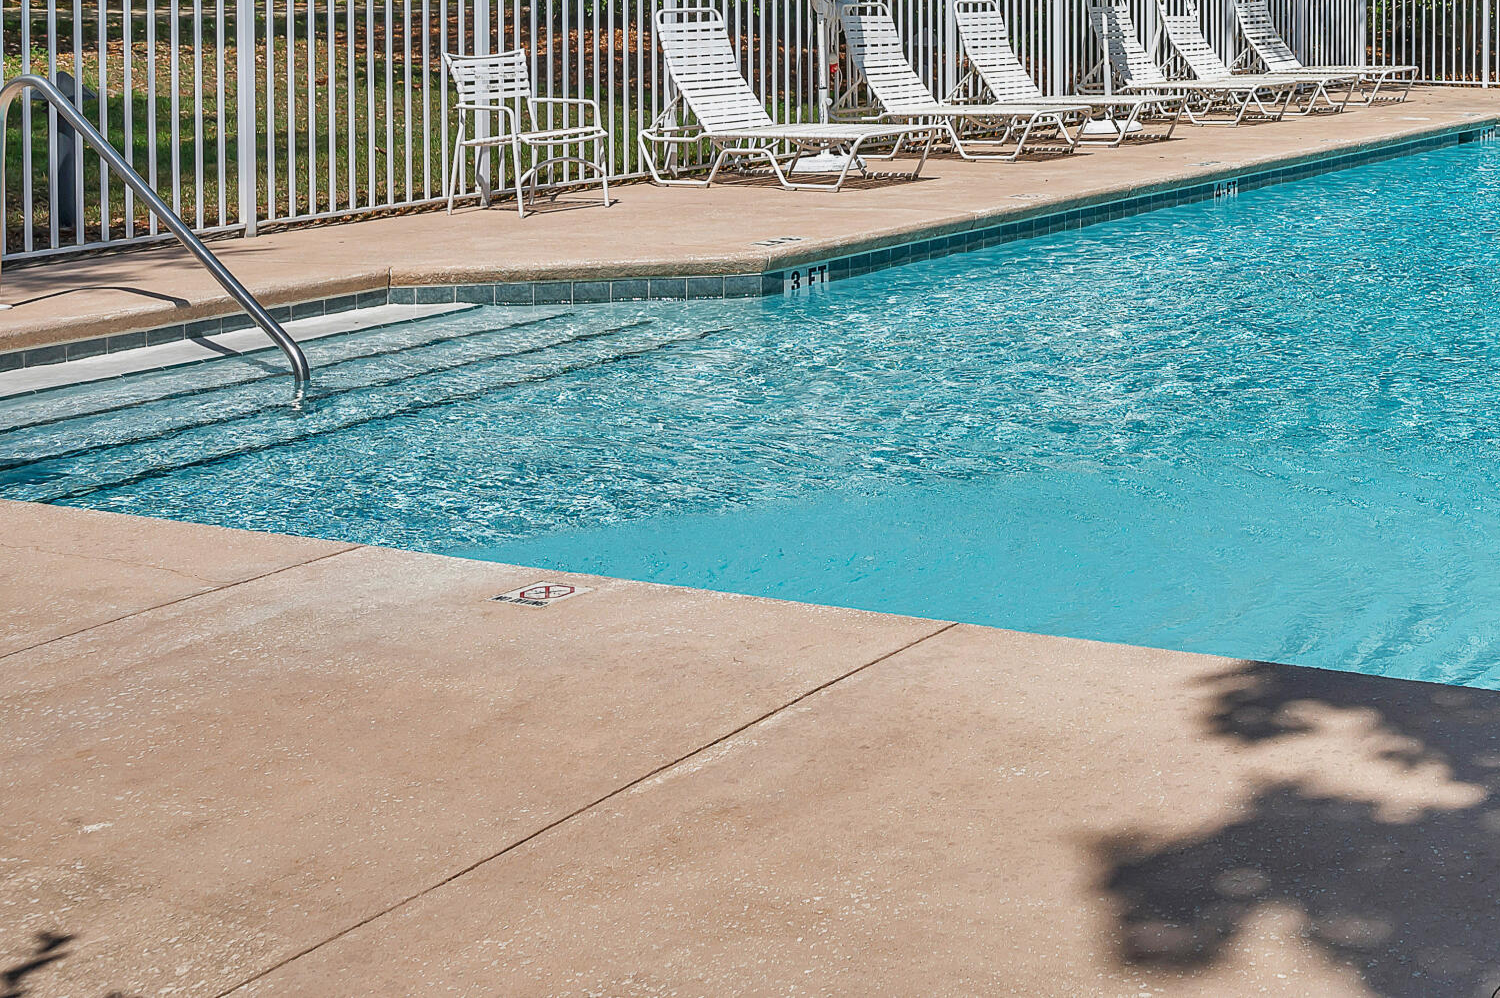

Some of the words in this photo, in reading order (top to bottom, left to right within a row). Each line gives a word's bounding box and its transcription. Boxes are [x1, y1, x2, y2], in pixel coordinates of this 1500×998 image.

[1226, 181, 1237, 195] FT
[790, 270, 801, 291] 3
[808, 265, 827, 287] FT
[508, 597, 549, 606] DIVING
